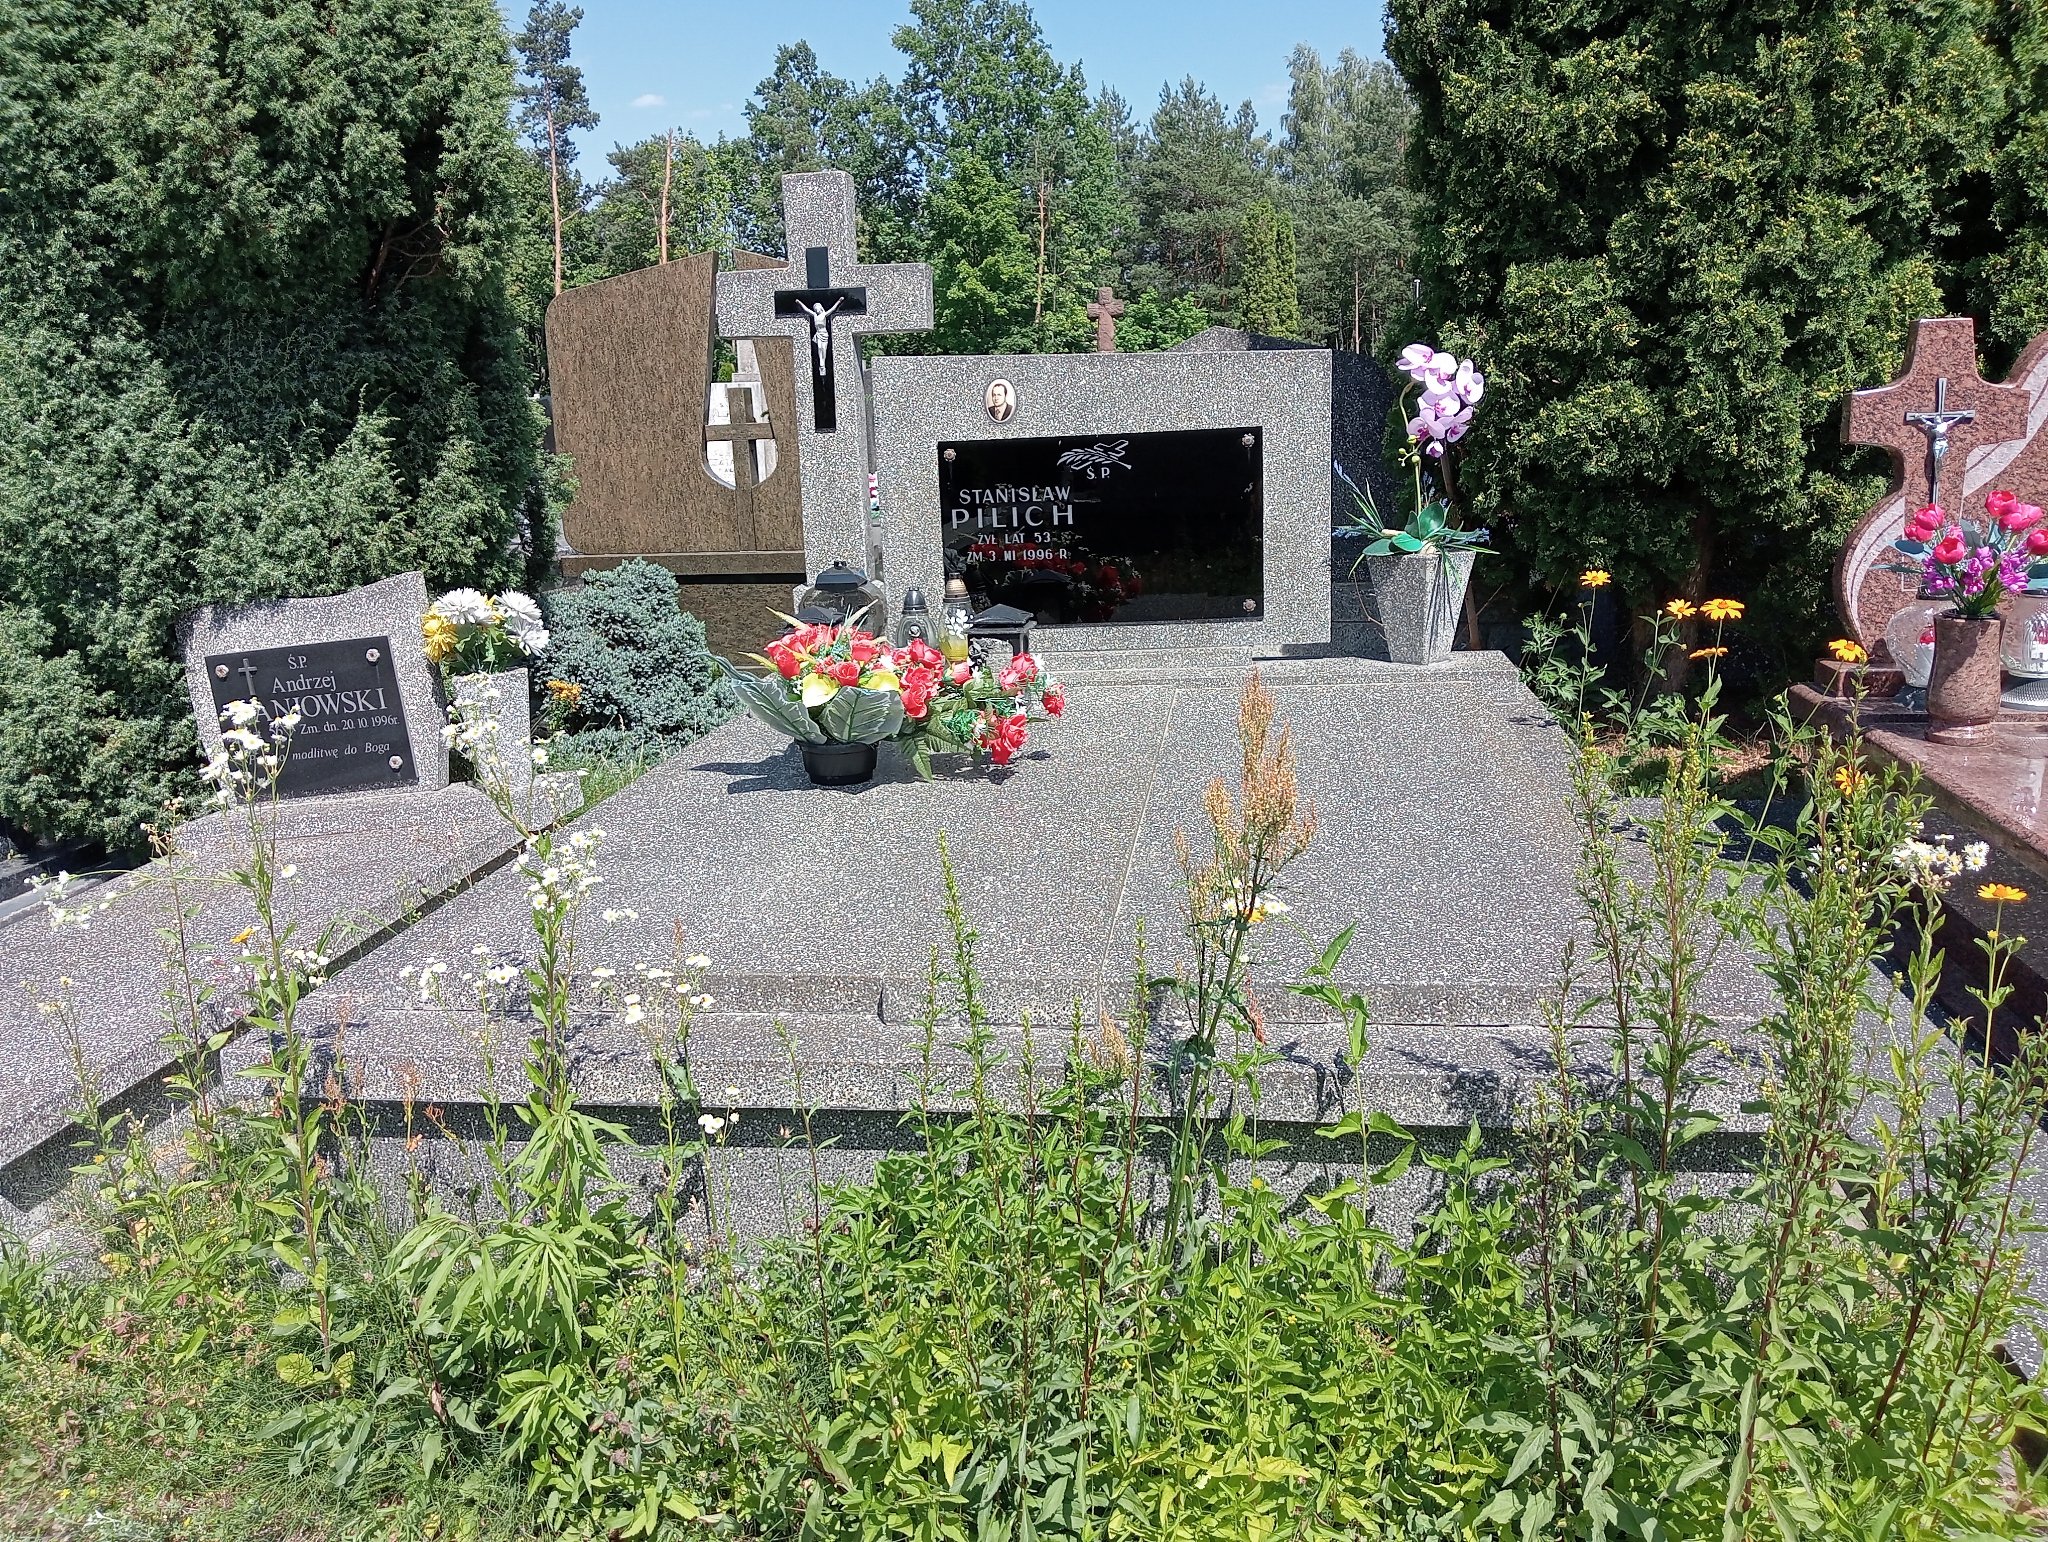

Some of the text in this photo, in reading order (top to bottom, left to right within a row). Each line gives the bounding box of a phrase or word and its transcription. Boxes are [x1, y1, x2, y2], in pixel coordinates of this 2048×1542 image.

[959, 485, 1071, 505] STANISŁAW
[951, 505, 1074, 529] PILICH
[977, 531, 1051, 545] ŻYŁ LAT 53
[988, 550, 996, 562] 3
[1023, 548, 1053, 561] 1996
[272, 670, 337, 694] Andrzej
[252, 688, 388, 722] ANIOWSKI
[300, 723, 320, 735] Zm.
[323, 721, 339, 732] dn.
[371, 715, 400, 728] 1996r.
[292, 748, 339, 761] modlitwę
[344, 744, 357, 756] do
[364, 742, 390, 755] Boga
